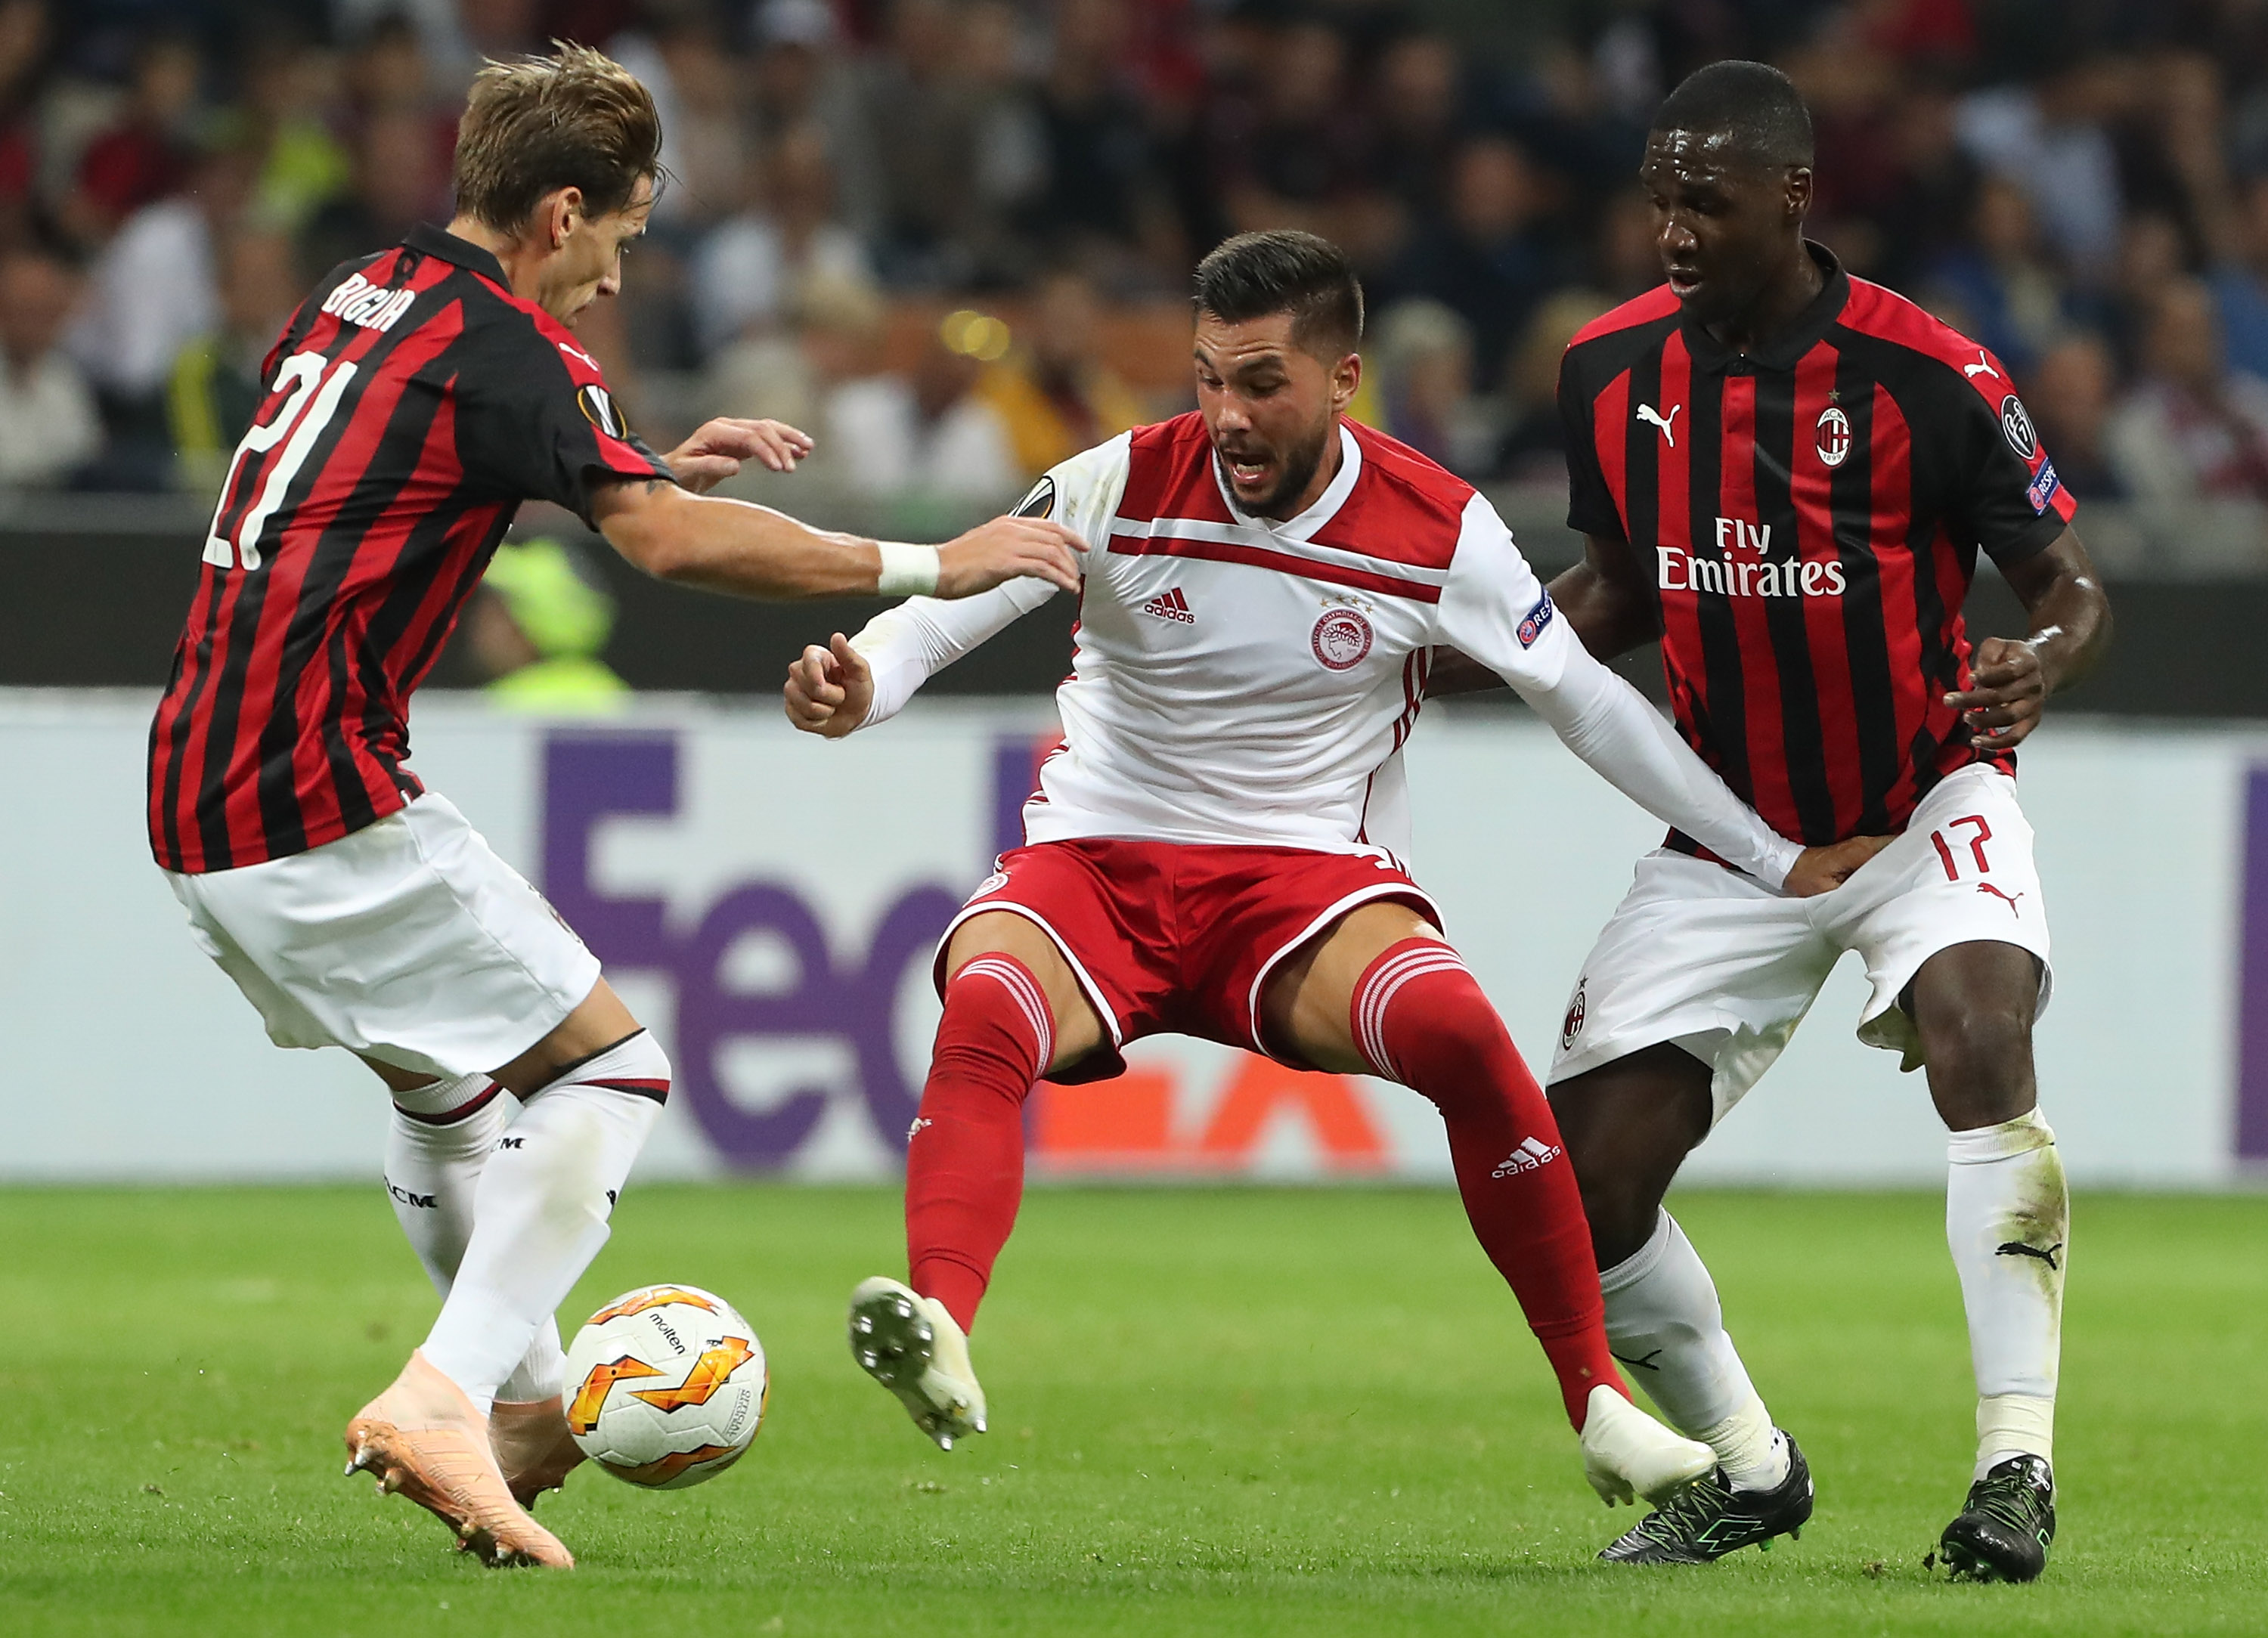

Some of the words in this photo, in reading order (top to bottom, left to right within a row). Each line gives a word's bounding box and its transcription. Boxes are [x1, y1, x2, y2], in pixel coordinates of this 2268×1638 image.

[321, 273, 415, 333] BIGLIA
[1823, 410, 1844, 421] ACM
[203, 351, 358, 571] 21
[1715, 517, 1771, 555] Fly
[1656, 546, 1846, 596] Emirates
[1144, 604, 1195, 624] adidas
[1930, 815, 1993, 881] 17
[1492, 1145, 1561, 1178] adidas
[649, 1313, 686, 1355] molten
